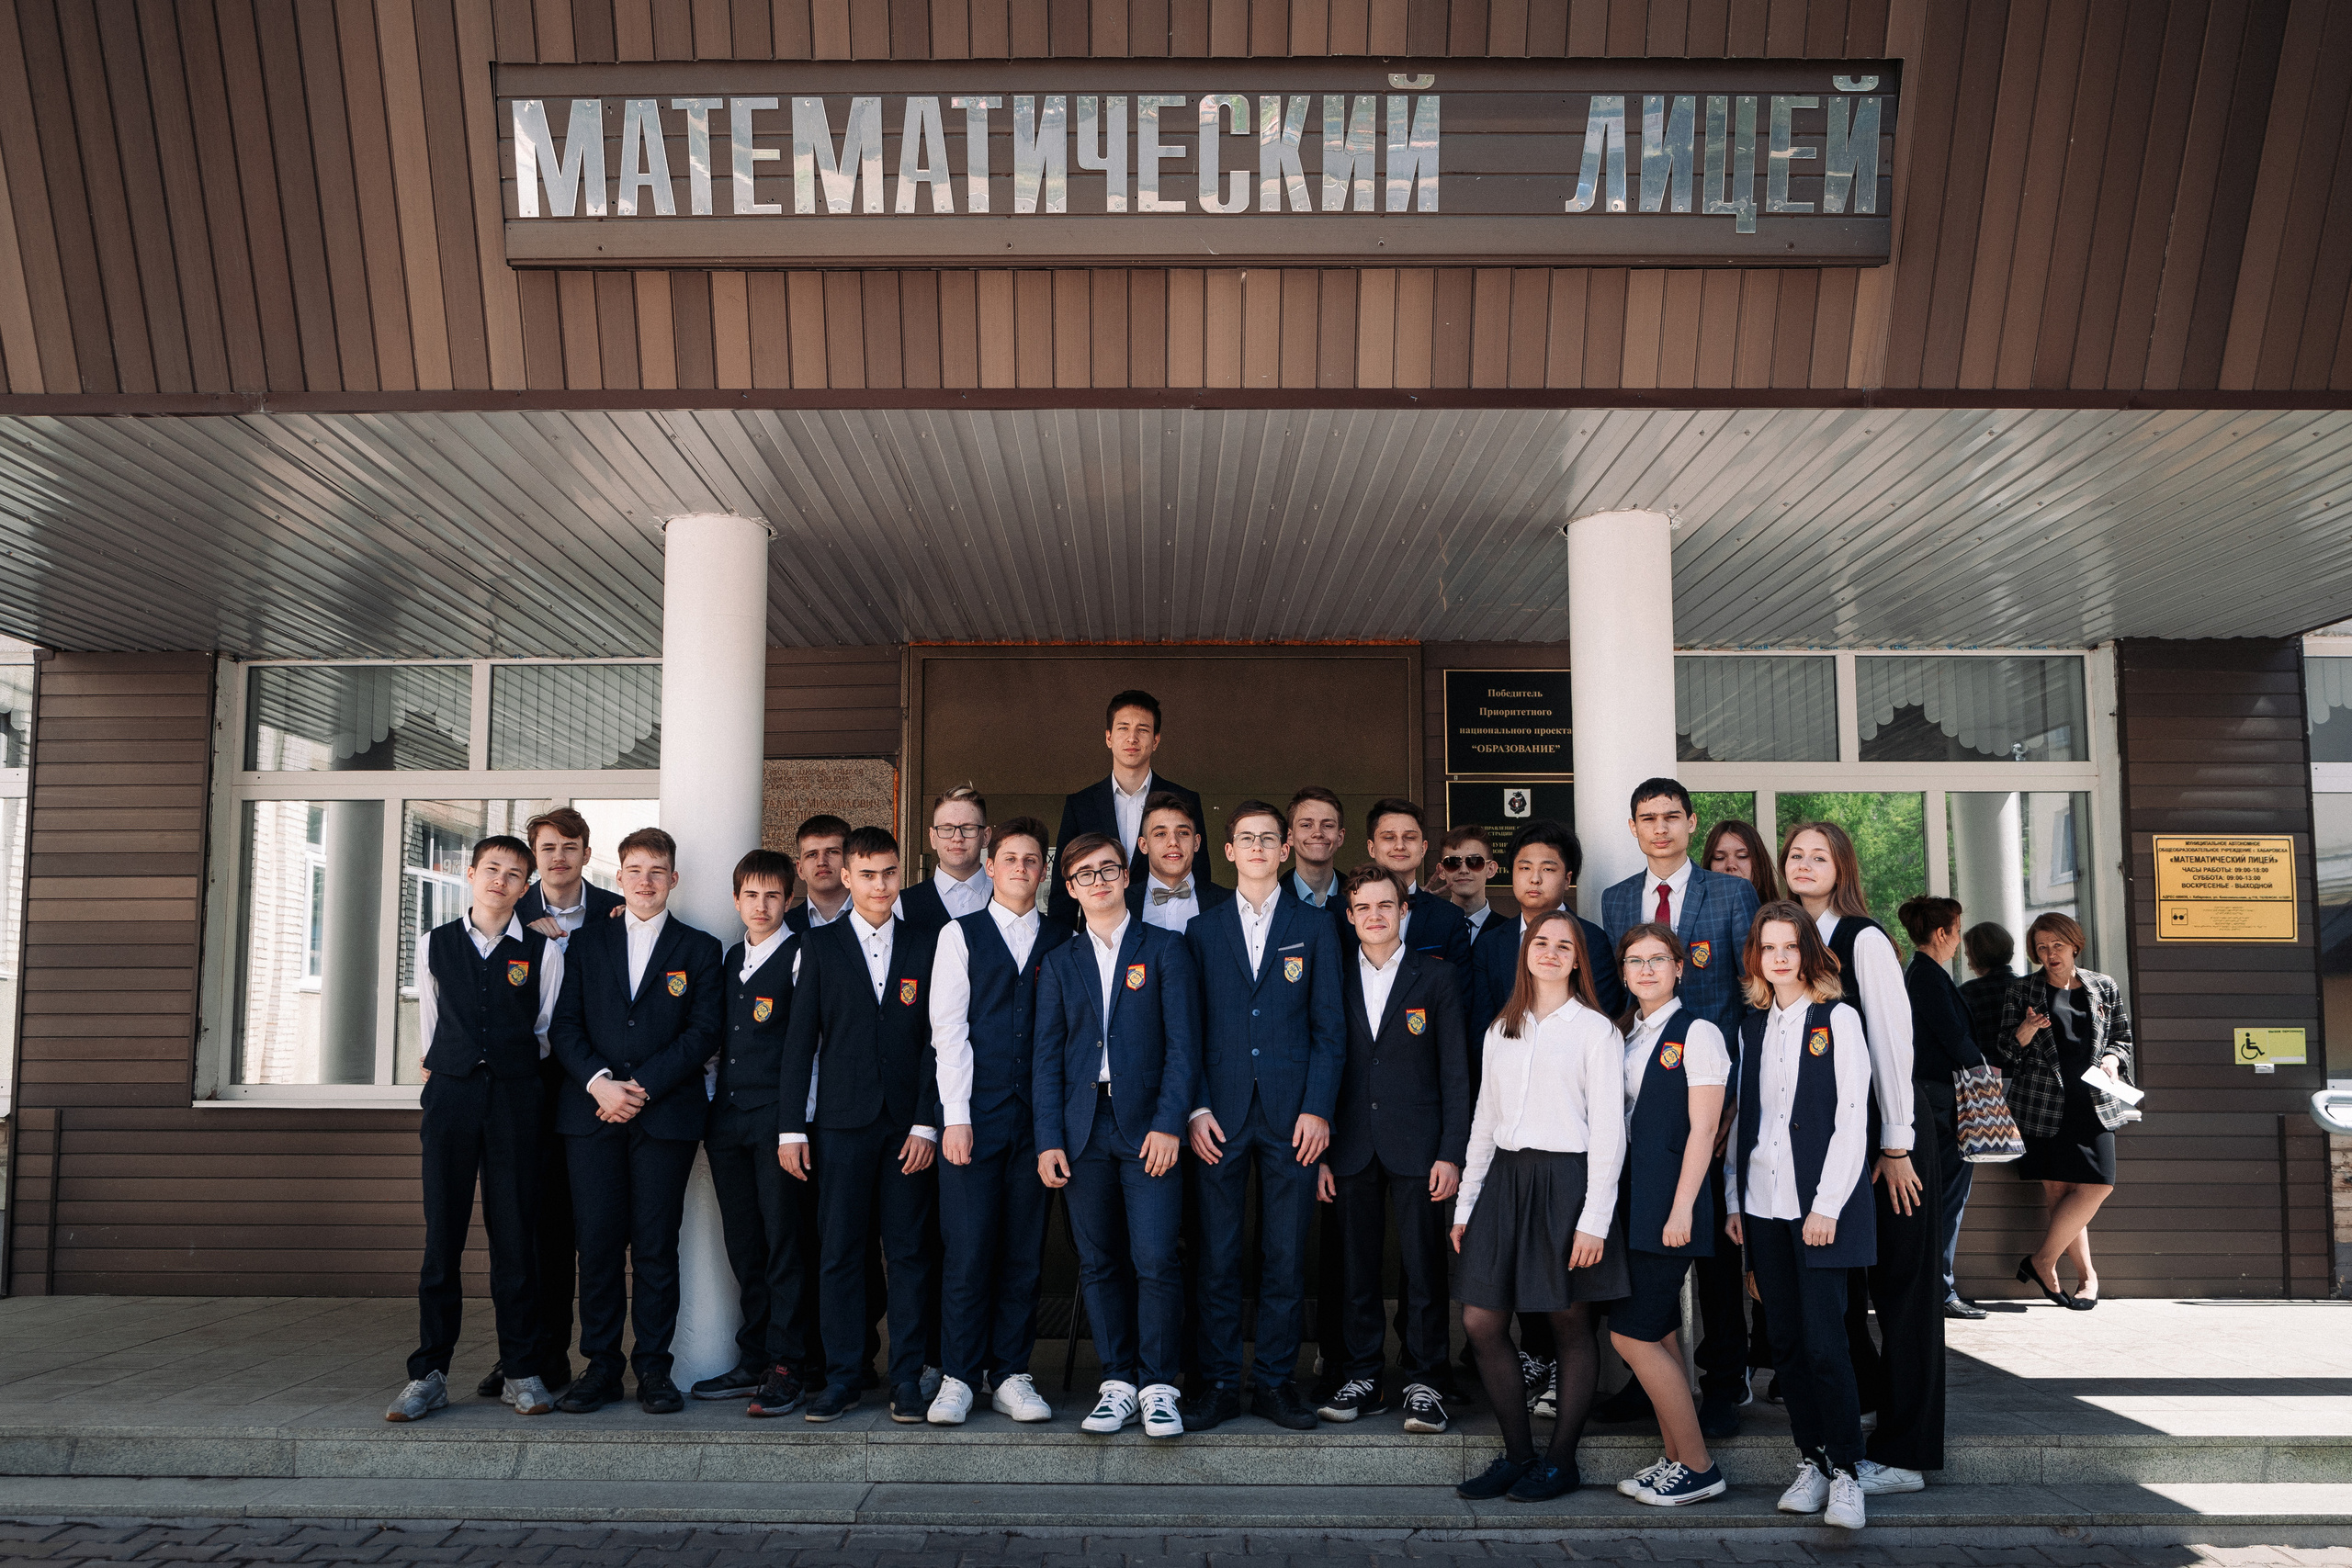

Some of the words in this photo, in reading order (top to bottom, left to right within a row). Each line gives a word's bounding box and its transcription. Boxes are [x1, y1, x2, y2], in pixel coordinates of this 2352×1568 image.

[512, 73, 1440, 218] МАТЕМАТИЧЕСКИЙ
[1565, 74, 1882, 234] ЛИЦЕЙ
[1487, 689, 1543, 698] Победитель
[1479, 707, 1553, 717] Приоритетного
[1459, 728, 1532, 736] национального
[1534, 728, 1572, 737] проекта
[2170, 854, 2246, 863] «МАТЕМАТИЧЕСКИЙ
[2248, 854, 2278, 864] ЛИЦЕЙ»
